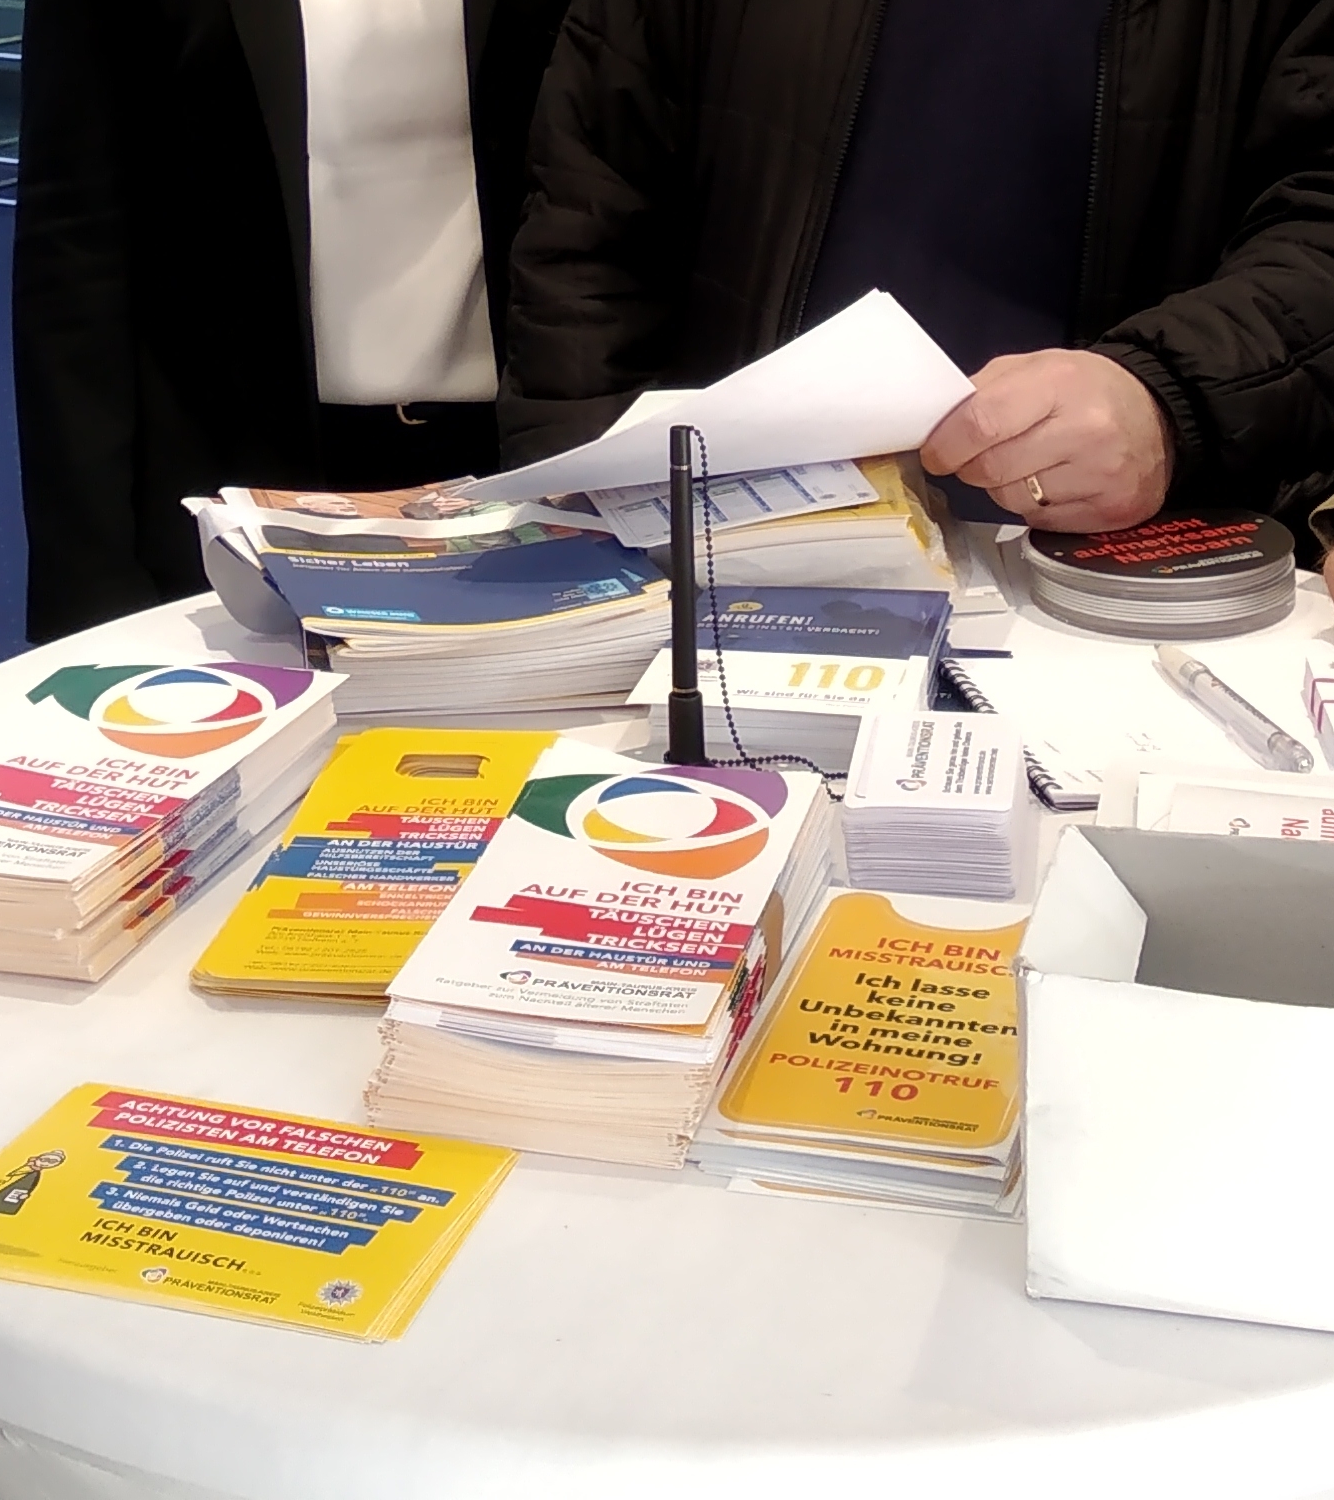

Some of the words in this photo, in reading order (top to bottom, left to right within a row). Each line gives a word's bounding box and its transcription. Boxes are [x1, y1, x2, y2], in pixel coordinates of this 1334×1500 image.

[1073, 520, 1260, 559] aufmerksame
[1117, 535, 1254, 564] Nachbarn
[287, 555, 346, 566] Sicher
[351, 560, 410, 568] Leben
[701, 614, 814, 626] ANRUFEN!
[788, 662, 885, 691] 110
[764, 690, 795, 698] sind
[798, 691, 820, 699] für
[823, 693, 844, 701] Sie
[6, 755, 66, 771] AUF
[66, 765, 124, 781] DER
[126, 775, 189, 791] HUT
[96, 757, 144, 771] ICH
[151, 766, 200, 780] BIN
[50, 778, 168, 804] TÄUSCHEN
[76, 794, 154, 813] LÜGEN
[421, 798, 456, 806] ICH
[32, 799, 141, 823] TRICKSEN
[356, 804, 397, 813] AUF
[404, 806, 446, 814] DER
[451, 807, 497, 815] HUT
[400, 815, 490, 825] TÄUSCHEN
[23, 814, 89, 830] HAUSTÜR
[90, 825, 122, 834] UND
[23, 823, 47, 831] AM
[49, 826, 113, 840] TELEFON
[398, 831, 483, 840] TRICKSEN
[428, 824, 487, 833] LÜGEN
[357, 840, 393, 848] DER
[397, 840, 478, 850] HAUSTÜR
[343, 883, 373, 891] AM
[378, 884, 457, 892] TELEFON
[379, 892, 452, 900] ENKELTRICK
[519, 883, 588, 899] AUF
[595, 892, 661, 909] DER
[669, 900, 740, 916] HUT
[620, 881, 684, 897] ICH
[686, 888, 744, 904] BIN
[588, 907, 730, 932] TÄUSCHEN
[586, 933, 719, 956] TRICKSEN
[632, 925, 724, 944] LÜGEN
[519, 943, 547, 952] AN
[550, 947, 585, 957] DER
[588, 950, 669, 966] HAUSTÜR
[672, 959, 711, 968] UND
[877, 937, 934, 954] ICH
[943, 945, 1001, 961] BIN
[596, 961, 627, 969] AM
[631, 963, 708, 977] TELEFON
[828, 947, 1014, 977] MISSTRAUISC
[436, 976, 493, 989] Ratgeber
[519, 988, 596, 1004] Vermeidung
[532, 977, 696, 1000] PRÄVENTIONSRAT
[855, 972, 901, 990] Ich
[911, 979, 991, 999] lasse
[518, 995, 572, 1007] Nachteil
[621, 1005, 686, 1015] Menschen
[866, 990, 956, 1013] keine
[799, 998, 1017, 1036] Unbekannten
[830, 1019, 860, 1034] in
[869, 1027, 973, 1048] meine
[808, 1032, 982, 1067] Wohnung!
[769, 1053, 1000, 1091] POLIZEINOTRUF
[834, 1076, 919, 1101] 110
[113, 1111, 242, 1141] POLIZISTEN
[238, 1135, 279, 1148] AM
[280, 1140, 381, 1165] TELEFON
[119, 1099, 232, 1125] ACHTUNG
[230, 1115, 277, 1134] VOR
[277, 1123, 393, 1152] FALSCHEN
[113, 1138, 126, 1149] 1.
[128, 1141, 153, 1155] Die
[156, 1145, 205, 1164] Polizei
[205, 1154, 233, 1168] ruft
[235, 1159, 259, 1172] Sie
[260, 1162, 298, 1178] nicht
[299, 1170, 341, 1185] unter
[341, 1177, 369, 1190] der
[417, 1194, 440, 1204] an.
[133, 1160, 148, 1171] 2.
[150, 1162, 197, 1182] Legen
[199, 1170, 222, 1183] Sie
[222, 1173, 251, 1188] auf
[250, 1179, 280, 1193] und
[281, 1184, 378, 1213] verständigen
[379, 1204, 405, 1216] Sie
[140, 1172, 165, 1185] die
[165, 1176, 224, 1199] richtige
[224, 1187, 274, 1205] Polizei
[275, 1197, 319, 1212] unter
[105, 1187, 119, 1197] 3.
[122, 1188, 182, 1208] Niemals
[184, 1199, 218, 1215] Geld
[220, 1208, 260, 1222] oder
[262, 1214, 350, 1239] Wertsachen
[111, 1201, 193, 1227] übergeben
[193, 1216, 232, 1231] oder
[232, 1223, 327, 1250] deponieren!
[91, 1217, 136, 1235] ICH
[137, 1226, 179, 1242] BIN
[79, 1231, 262, 1277] MISSTRAUISCH...
[162, 1276, 278, 1305] PRÄVENTIONSRAT
